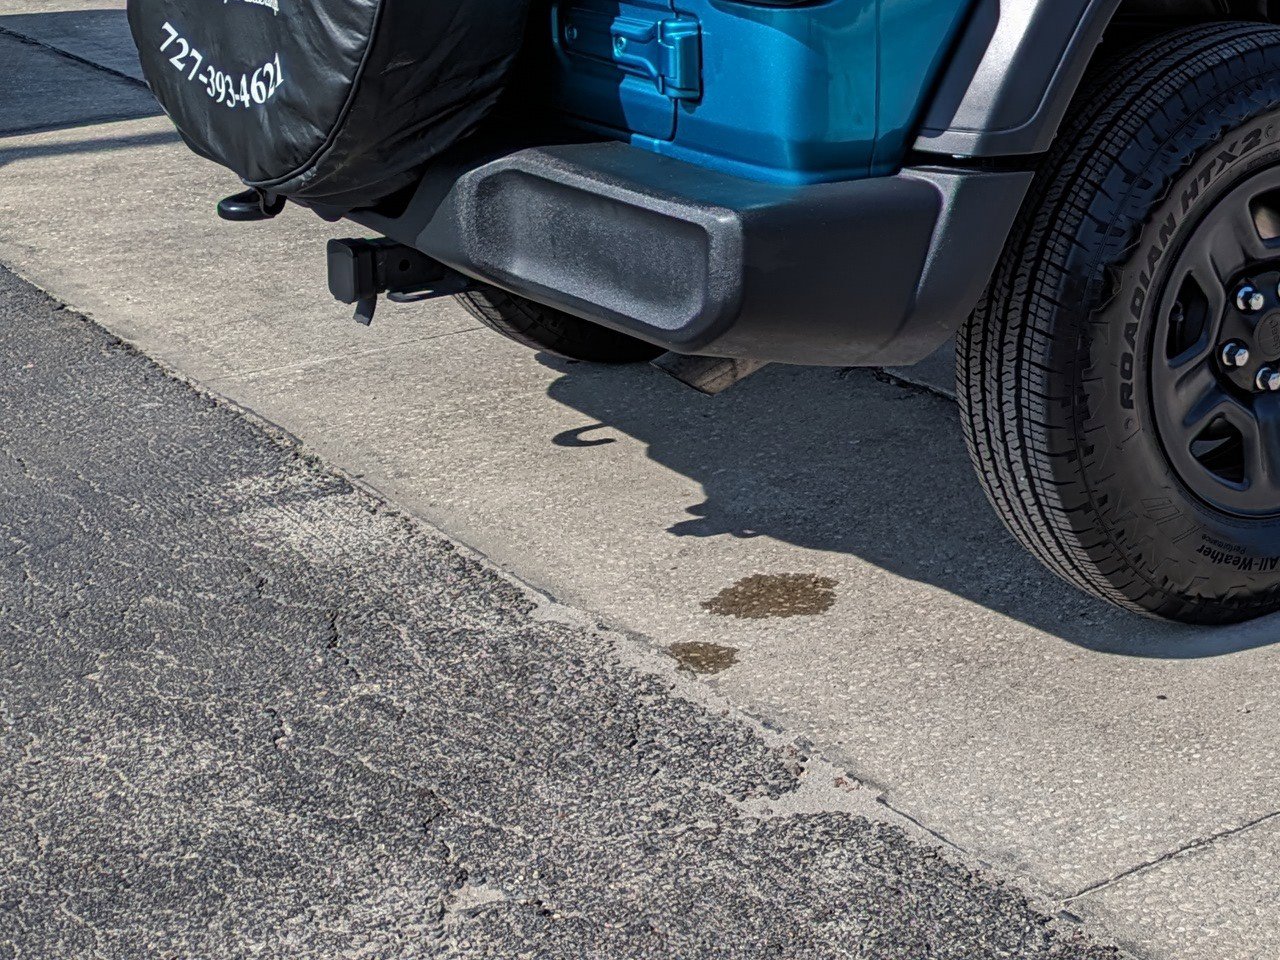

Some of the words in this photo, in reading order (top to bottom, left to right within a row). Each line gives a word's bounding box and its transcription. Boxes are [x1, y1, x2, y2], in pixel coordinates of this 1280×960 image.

[159, 21, 285, 108] 727-393-4621
[1119, 212, 1176, 411] ROADIAN
[1195, 544, 1280, 571] All-Weather
